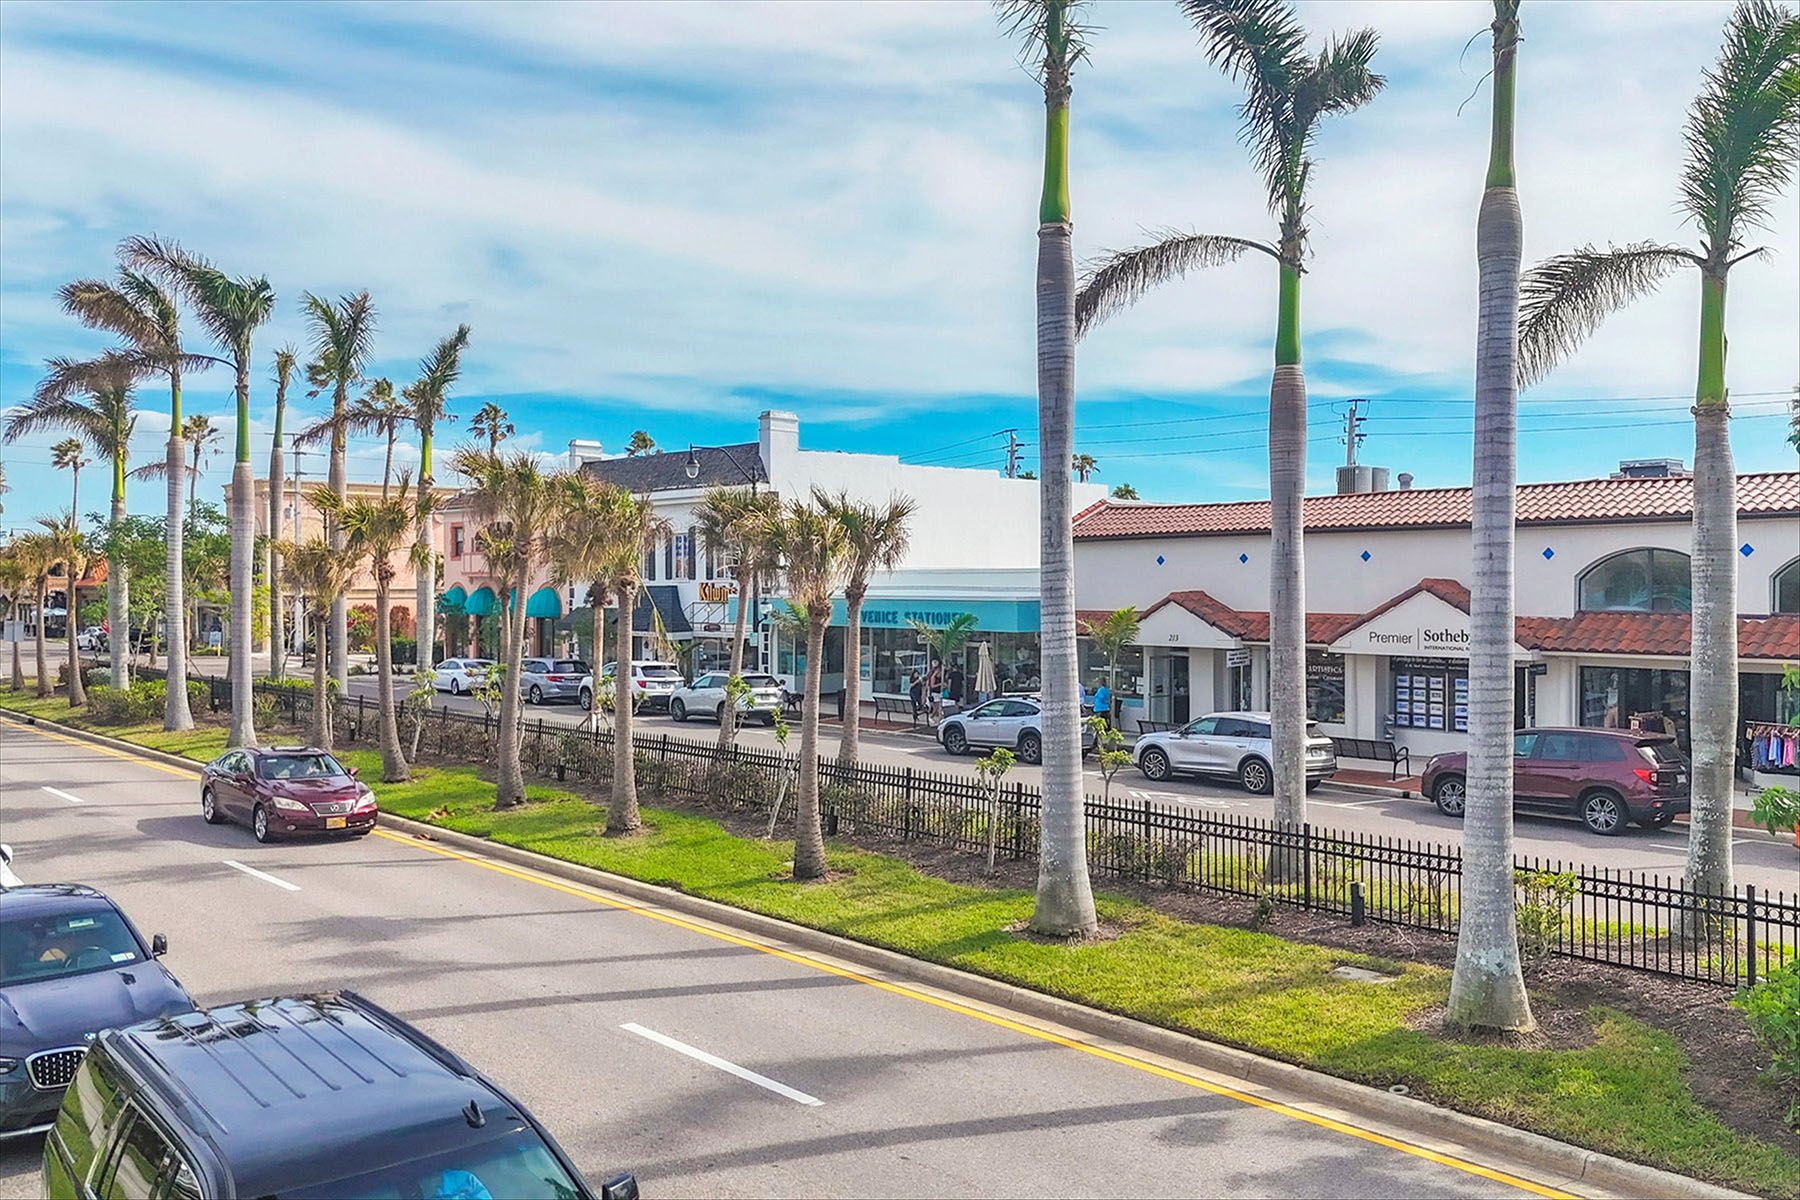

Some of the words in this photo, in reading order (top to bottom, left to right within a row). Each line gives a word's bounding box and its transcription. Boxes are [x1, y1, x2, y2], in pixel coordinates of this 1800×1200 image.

[699, 582, 738, 601] Kilwin's
[860, 610, 899, 625] VENICE
[1369, 631, 1413, 644] Premier
